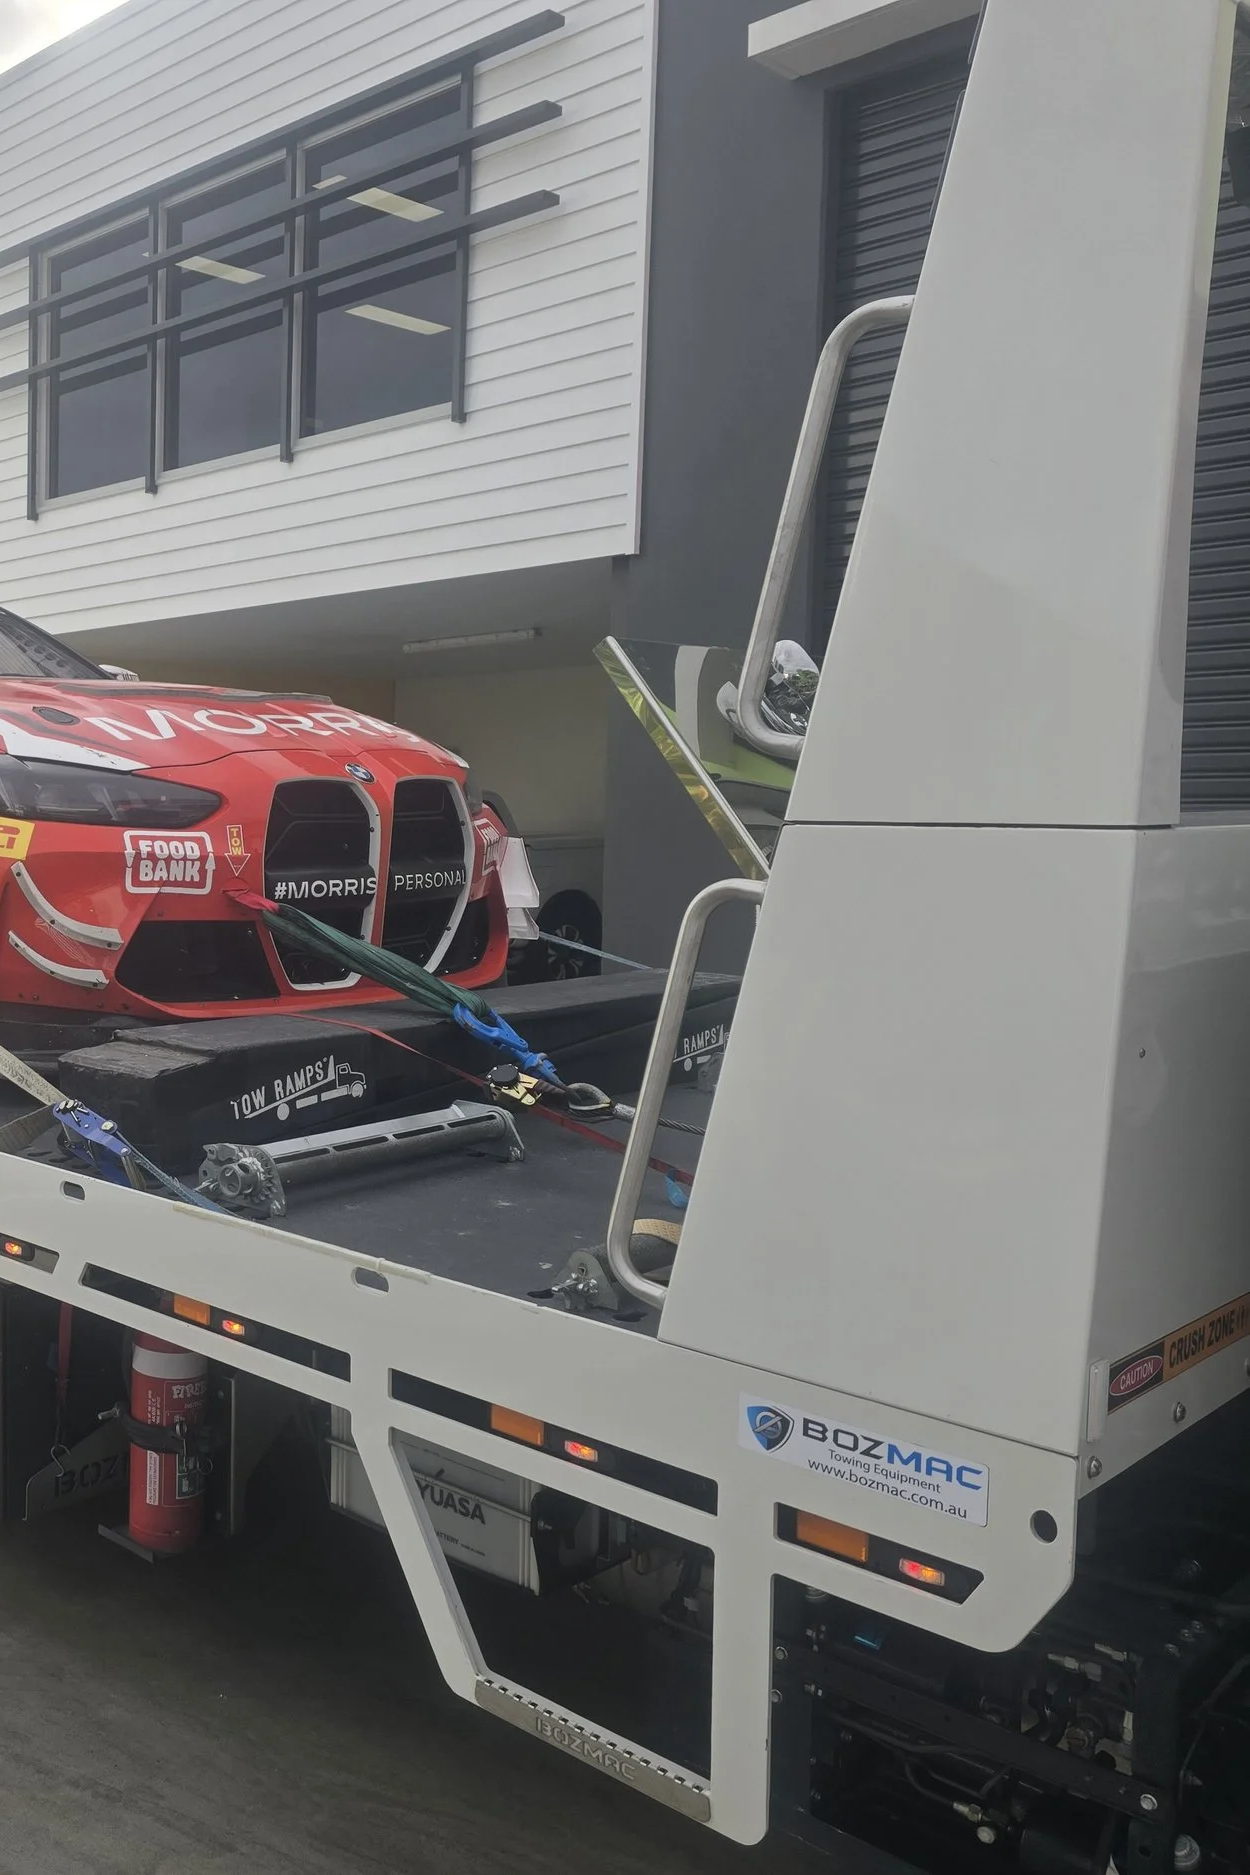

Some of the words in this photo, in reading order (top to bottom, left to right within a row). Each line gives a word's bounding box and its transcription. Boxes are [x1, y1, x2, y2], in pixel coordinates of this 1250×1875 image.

[138, 839, 201, 860] FOOD
[230, 828, 242, 855] TOW
[138, 860, 201, 883] BANK
[274, 877, 378, 900] #MORRIS
[394, 869, 467, 892] PERSONAL
[683, 1027, 717, 1055] RAMPS
[230, 1086, 266, 1120] TOW
[274, 1061, 325, 1101] RAMPS
[1119, 1359, 1155, 1391] CAUTION
[1169, 1325, 1206, 1369] CRUSH
[1207, 1309, 1235, 1348] ZONE
[802, 1416, 984, 1491] BOZMAC
[828, 1448, 872, 1474] Towing
[873, 1463, 942, 1495] Equipment
[413, 1478, 487, 1526] YUASA
[807, 1458, 968, 1520] www.bozmac.com.au
[535, 1716, 636, 1781] BOZMAC
